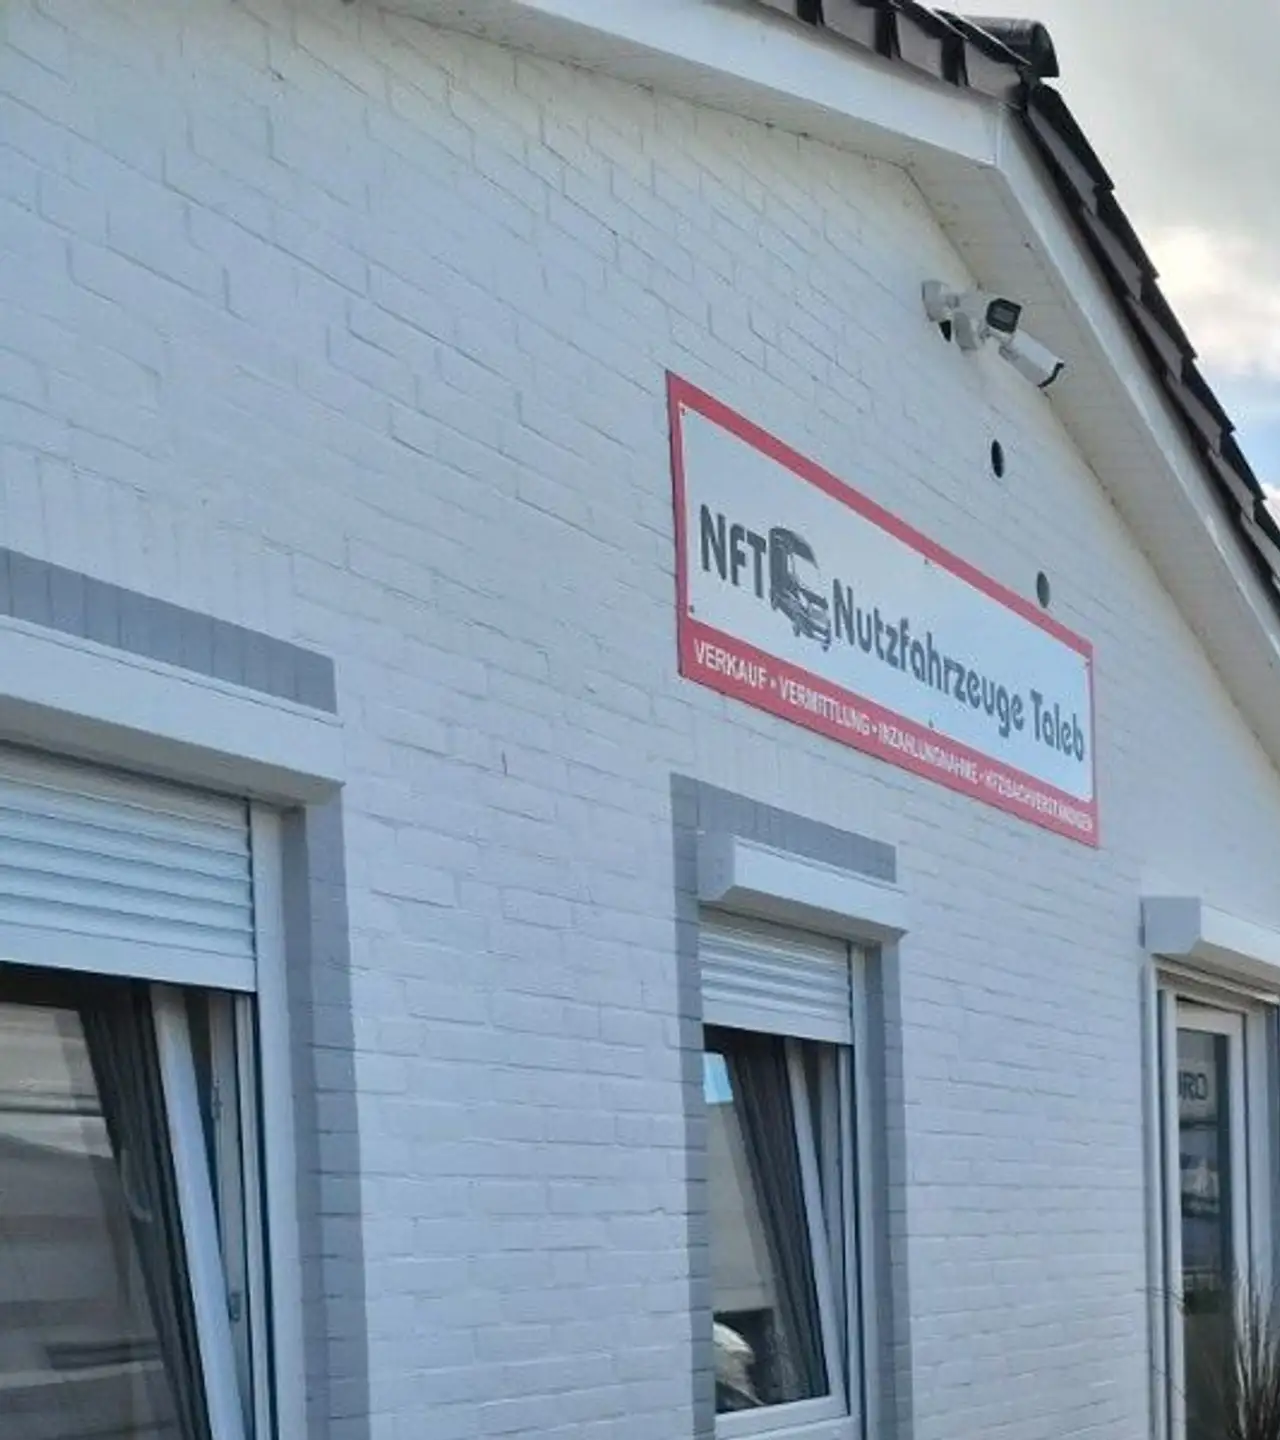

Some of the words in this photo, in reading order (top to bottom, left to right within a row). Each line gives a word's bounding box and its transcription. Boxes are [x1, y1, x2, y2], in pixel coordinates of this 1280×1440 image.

[693, 638, 767, 690] VERKAUF
[778, 675, 870, 736] VERMITTLUNG
[833, 578, 1025, 738] Nutzfahrzeuge
[1030, 688, 1084, 762] Taleb
